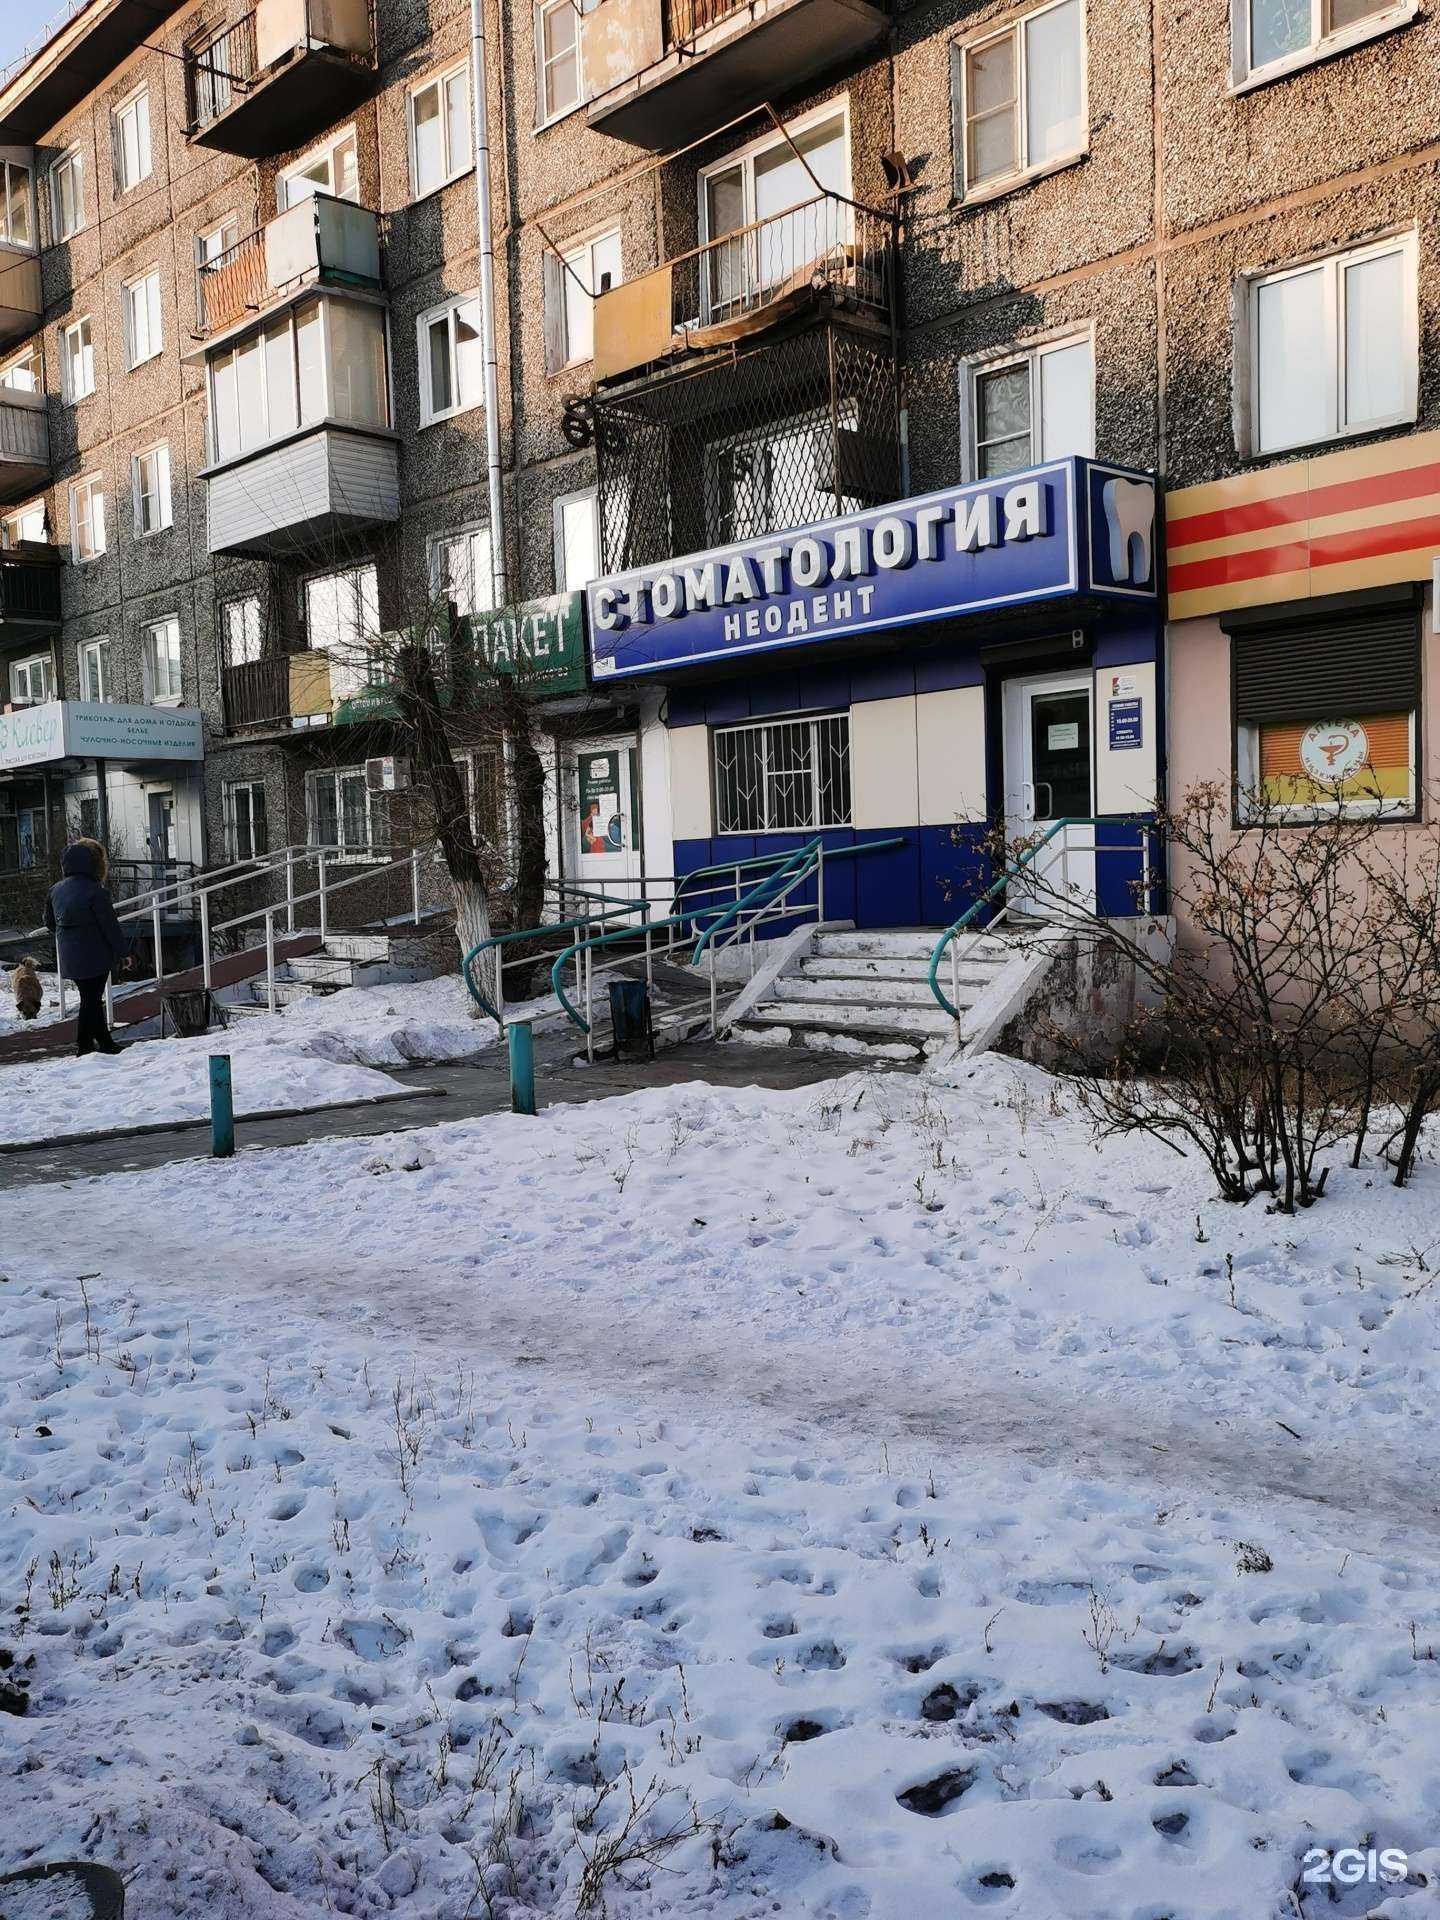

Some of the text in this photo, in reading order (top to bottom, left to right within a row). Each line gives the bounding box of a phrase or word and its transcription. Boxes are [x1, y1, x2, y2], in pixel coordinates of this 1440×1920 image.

[594, 481, 1047, 631] СТОМАТОЛОГИЯ
[724, 584, 876, 641] НЕОДЕНТ
[75, 715, 115, 723] ТРИКОТАЖ
[166, 719, 197, 727] ОТДЫХА
[1307, 718, 1360, 742] АПТЕКА
